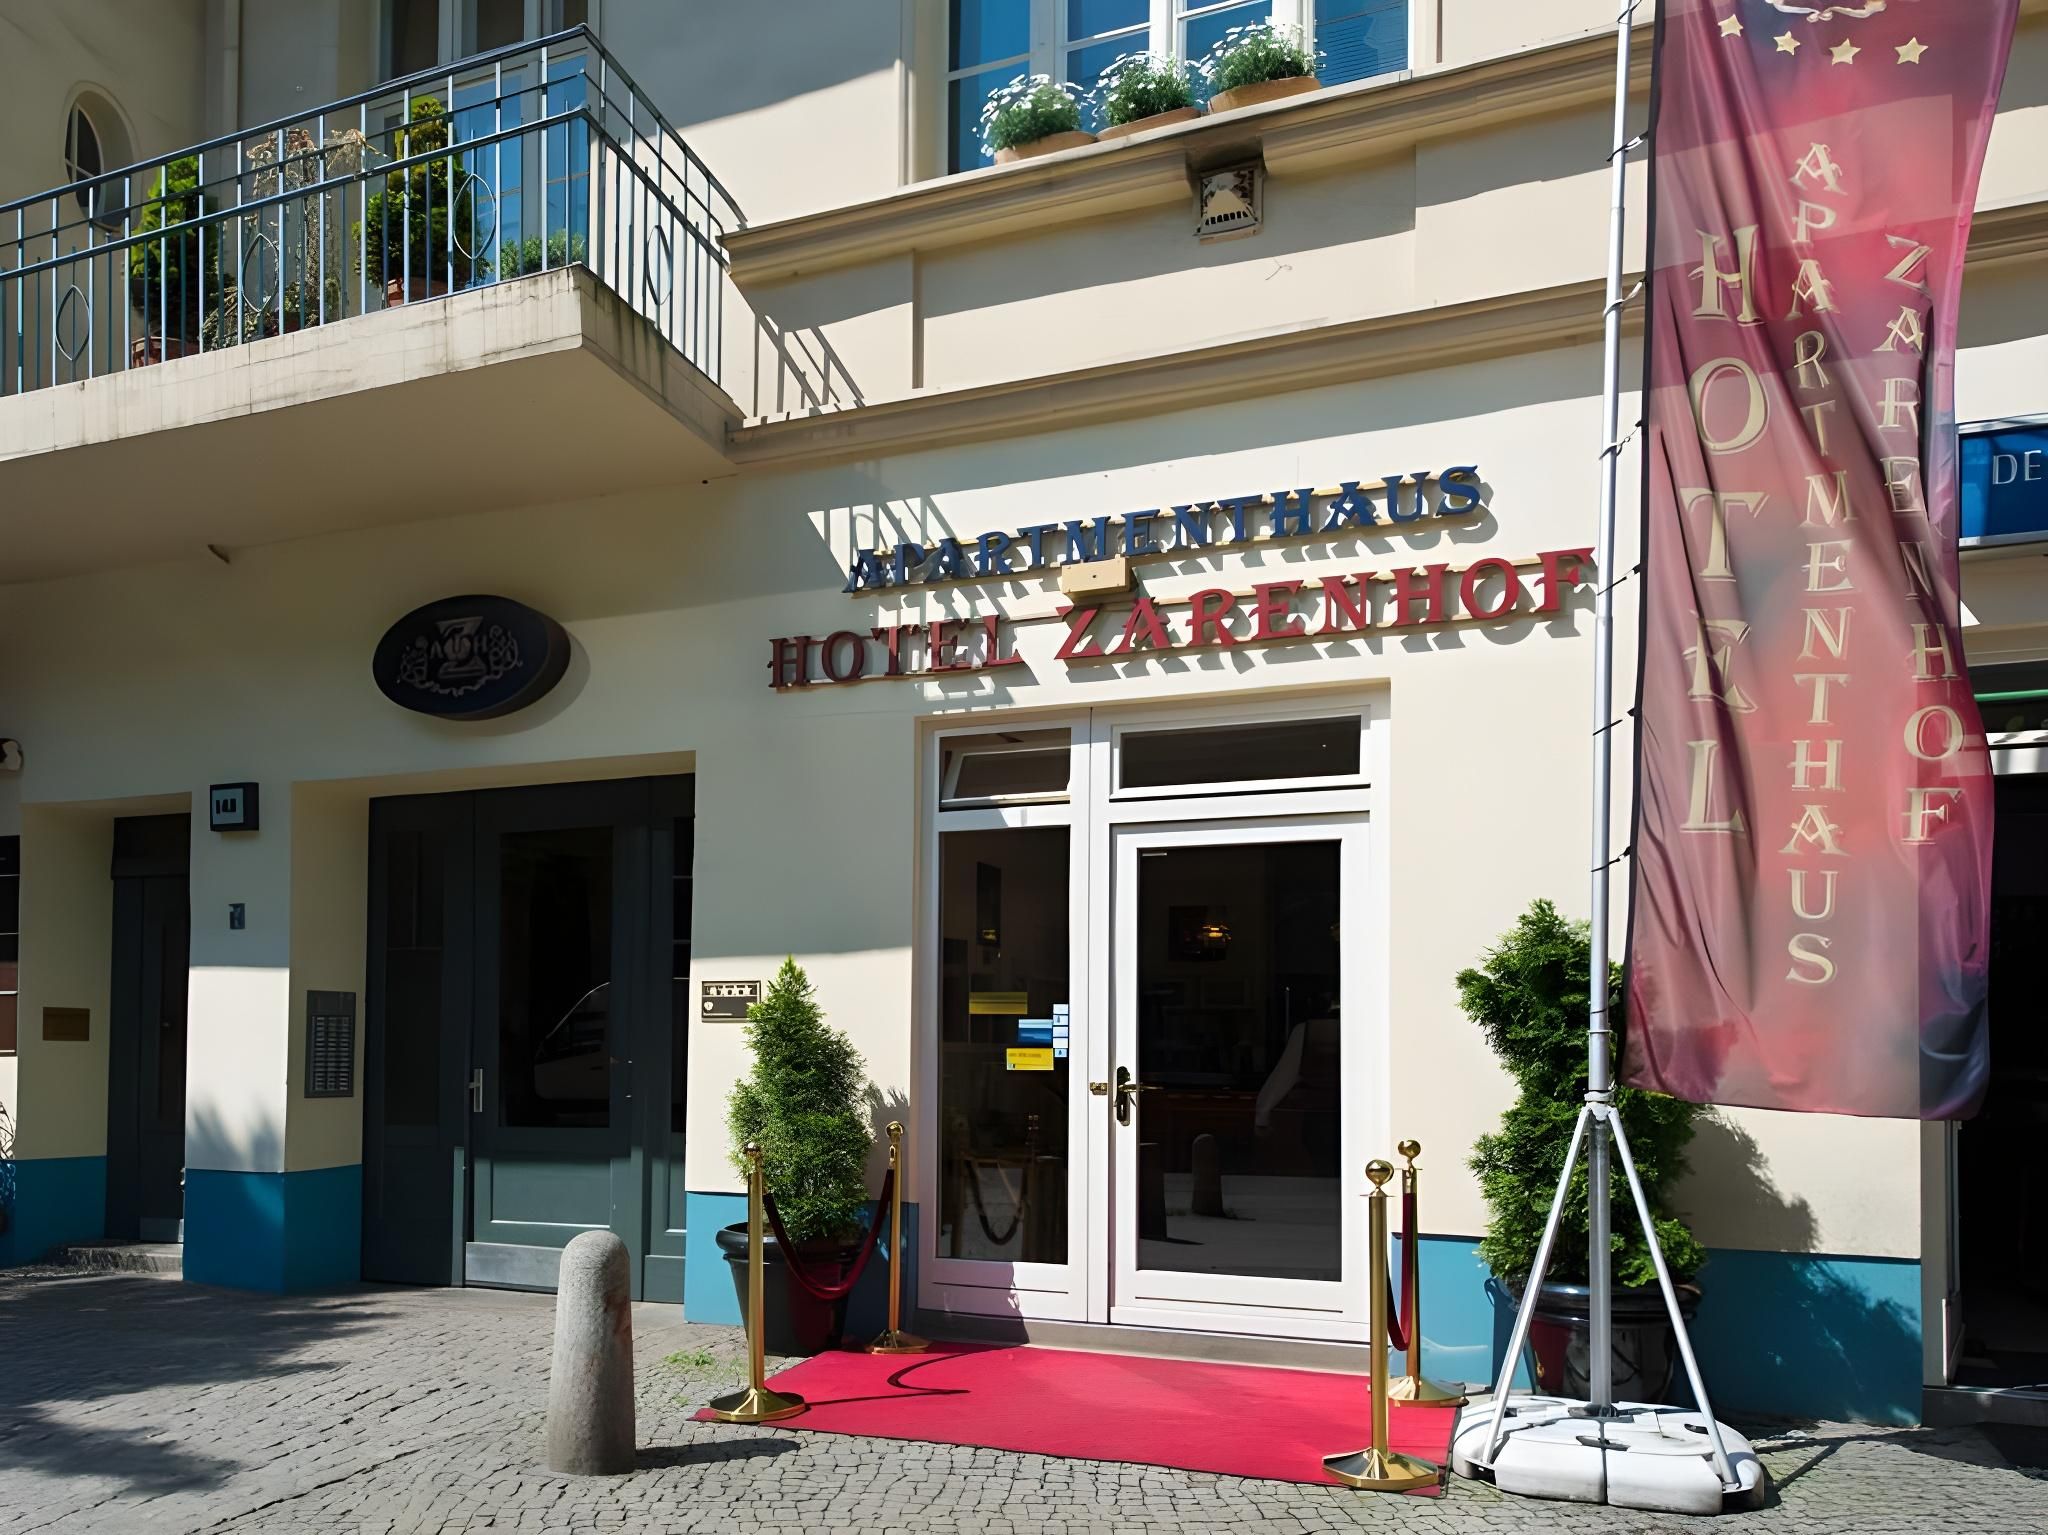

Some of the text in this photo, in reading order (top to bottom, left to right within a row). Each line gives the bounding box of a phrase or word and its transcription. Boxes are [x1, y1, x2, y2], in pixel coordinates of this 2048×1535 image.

[767, 547, 1596, 687] HOTEL ZARENHOF
[841, 465, 1481, 593] APARTMENTHAUS
[1680, 224, 1770, 834] HOTEL
[1778, 142, 1859, 984] APARTMENTHAUS
[1873, 234, 1965, 845] ZARENHOF
